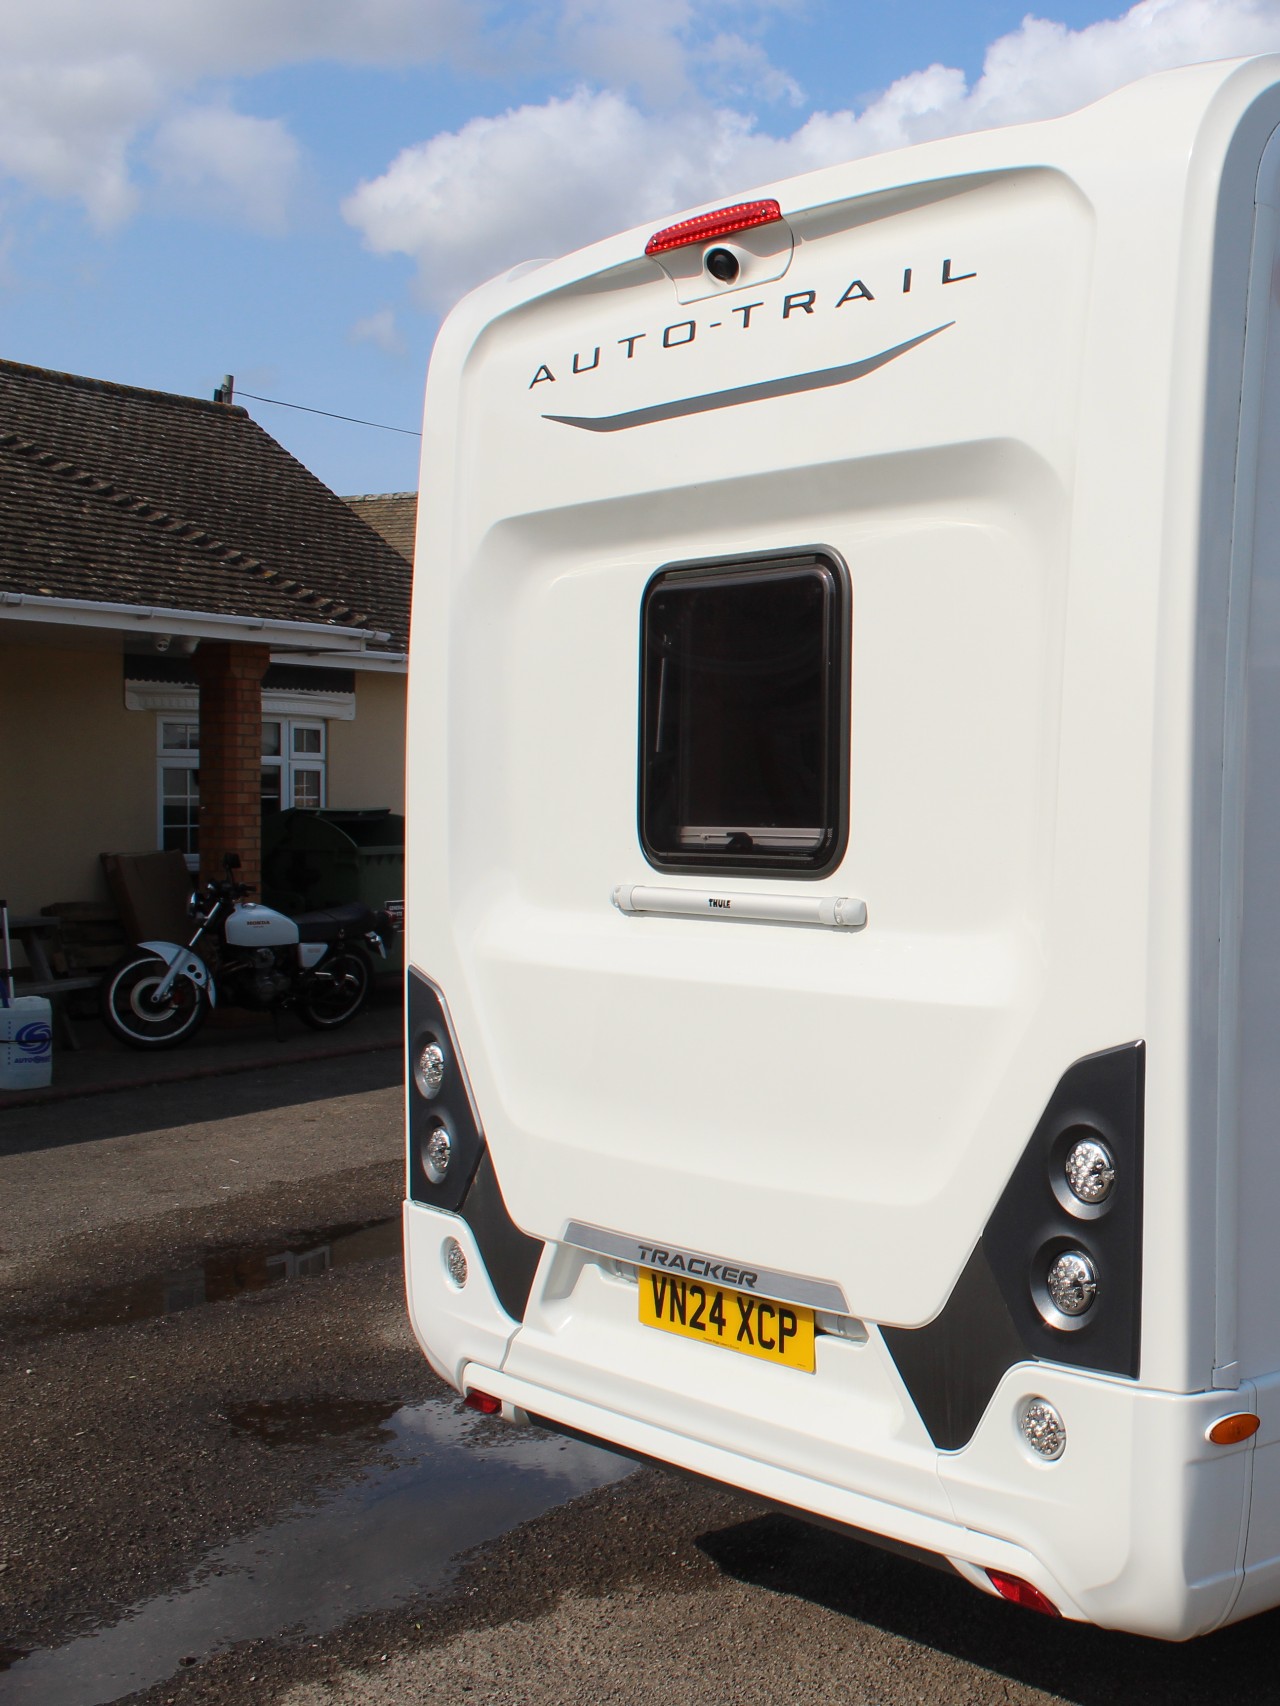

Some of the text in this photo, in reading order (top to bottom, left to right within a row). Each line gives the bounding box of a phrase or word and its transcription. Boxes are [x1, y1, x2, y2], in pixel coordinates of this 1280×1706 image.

[528, 258, 978, 389] AUTO-TRAIL
[708, 898, 731, 909] THULE
[637, 1245, 758, 1289] TRACKER
[651, 1273, 798, 1354] VN24 XCP
